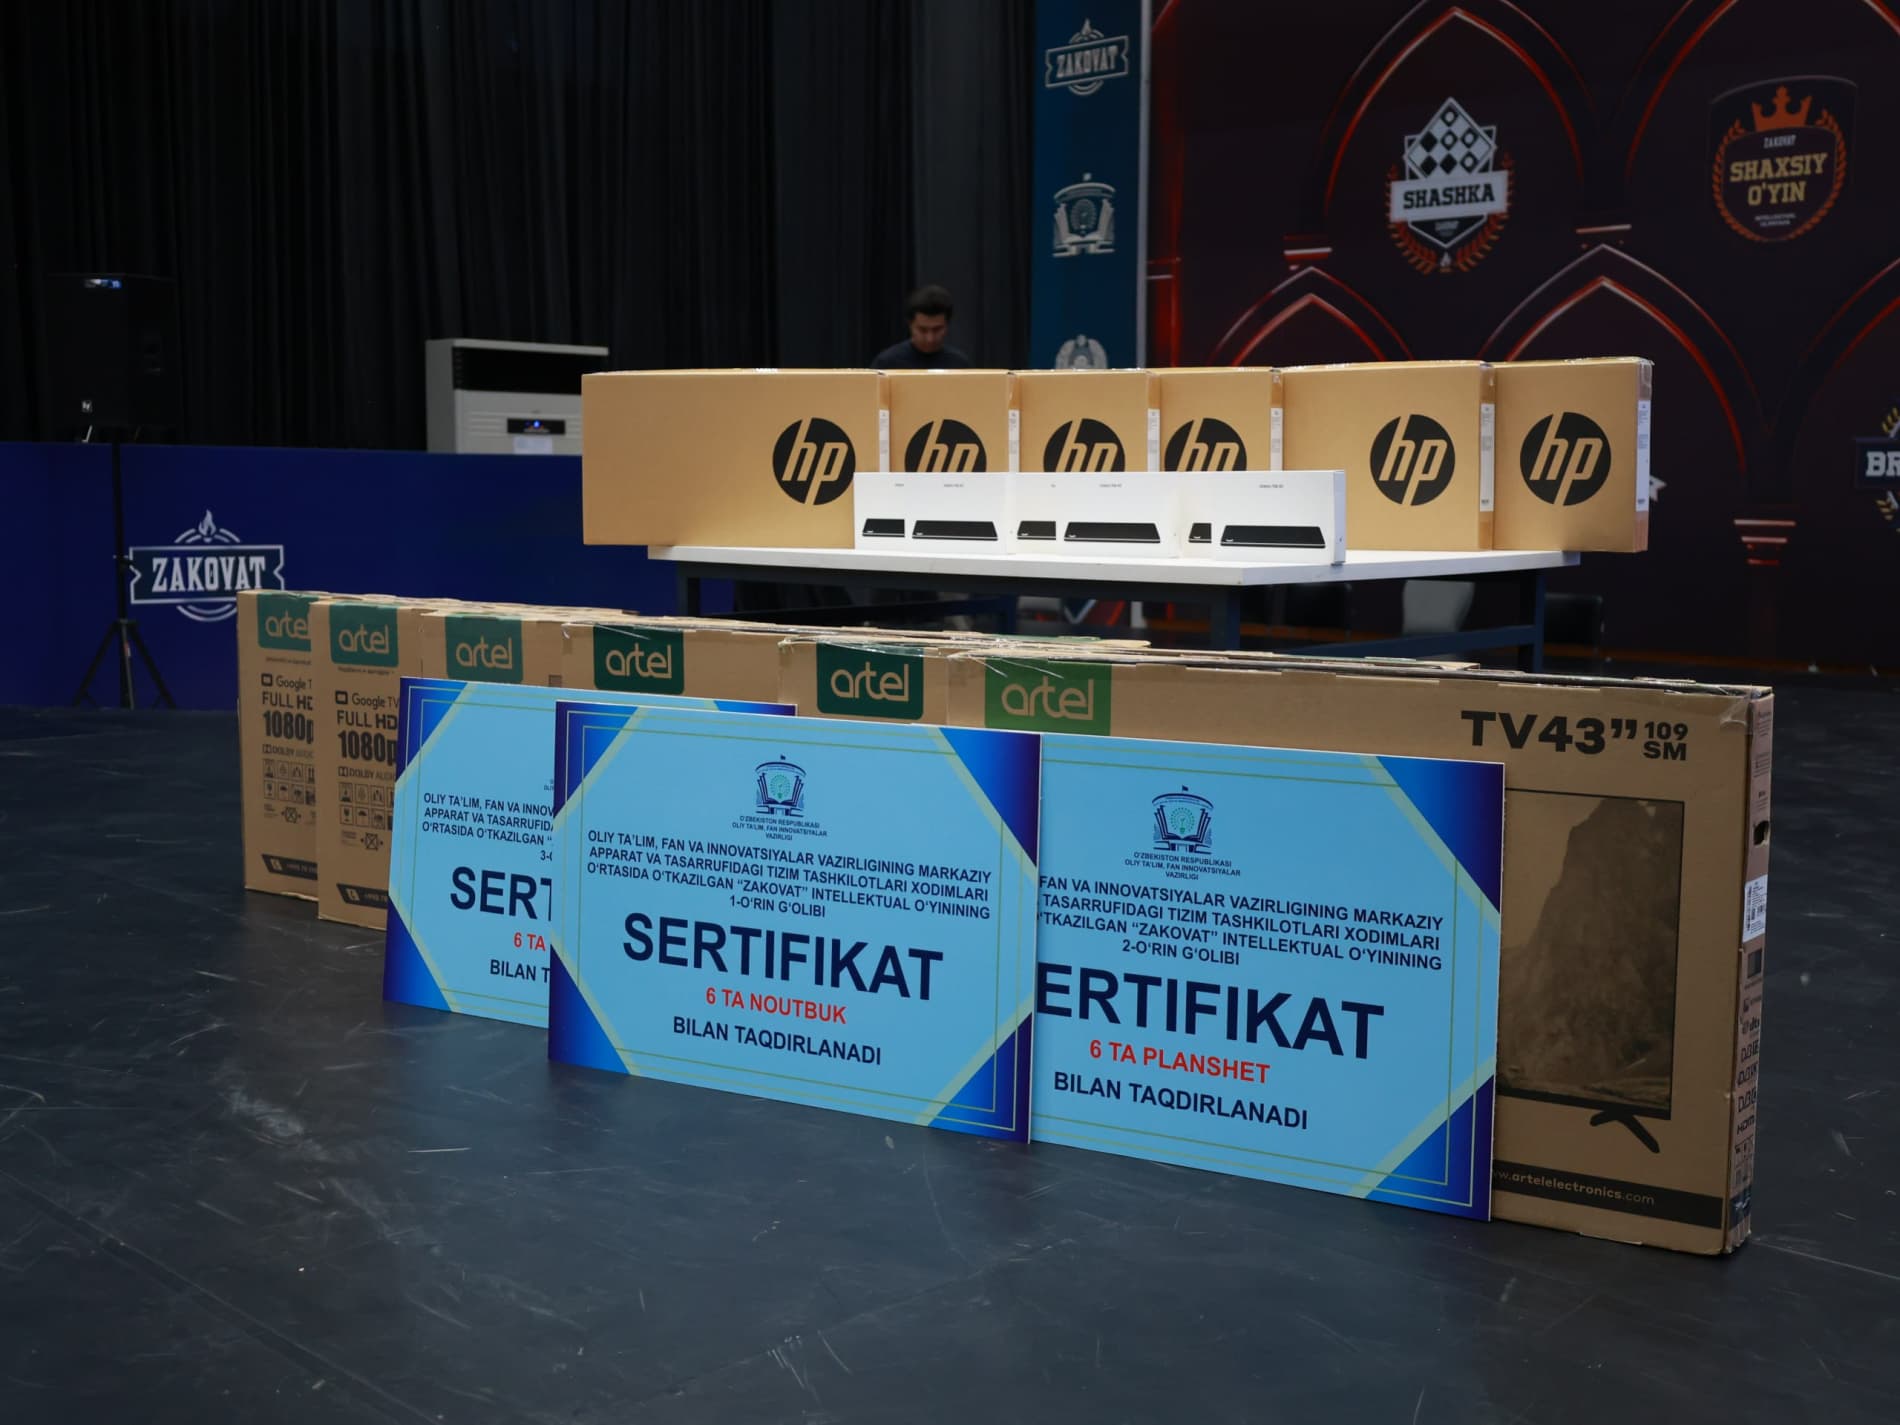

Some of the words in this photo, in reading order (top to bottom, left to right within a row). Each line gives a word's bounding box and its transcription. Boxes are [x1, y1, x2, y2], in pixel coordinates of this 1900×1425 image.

[1056, 45, 1118, 78] ZAKOVAT
[1729, 152, 1828, 182] SHAXSIY
[1403, 183, 1495, 210] SHASHKA
[1747, 181, 1807, 206] O'YIN
[781, 417, 849, 505] hp
[1378, 414, 1448, 506] hp
[1529, 412, 1603, 506] hp
[152, 556, 266, 592] ZAKOVAT
[338, 624, 390, 655] artel
[456, 636, 513, 670] artel
[606, 643, 672, 679] artel
[275, 675, 306, 692] Google
[830, 661, 910, 702] artel
[1001, 675, 1094, 721] artel
[262, 691, 294, 709] FULL
[352, 692, 385, 710] Google
[336, 710, 372, 728] FULL
[375, 713, 397, 730] HD
[1644, 721, 1688, 741] 109
[1643, 740, 1687, 761] SM
[423, 792, 446, 805] OLIY
[485, 799, 504, 811] FAN
[507, 802, 520, 813] VA
[424, 807, 469, 820] APPARAT
[471, 813, 485, 824] VA
[486, 814, 553, 832] TASARRUFID
[588, 830, 615, 844] OLIY
[661, 837, 685, 851] FAN
[688, 840, 704, 853] VA
[707, 842, 814, 866] INNOVATSIYALAR
[818, 854, 915, 876] VAZIRLIGINING
[918, 865, 992, 884] MARKAZIY
[1124, 859, 1140, 867] OLIY
[1166, 862, 1180, 871] FAN
[1181, 864, 1241, 877] INNOVATSIYALAR
[1180, 855, 1232, 868] RESPUBLIKASI
[589, 847, 642, 863] APPARAT
[646, 852, 661, 865] VA
[665, 854, 763, 877] TASARRUFIDAGI
[767, 865, 800, 881] TIZIM
[803, 869, 907, 892] TASHKILOTLARI
[911, 881, 988, 902] XODIMLARI
[1165, 871, 1199, 880] VAZIRLIGI
[811, 887, 910, 910] INTELLEKTUAL
[1039, 876, 1067, 890] FAN
[1072, 879, 1090, 894] VA
[1094, 880, 1225, 907] INNOVATSIYALAR
[1229, 895, 1348, 921] VAZIRLIGINING
[1354, 908, 1443, 931] MARKAZIY
[1037, 912, 1127, 934] ‘TKAZILGAN
[1223, 932, 1344, 959] INTELLEKTUAL
[1043, 894, 1163, 919] TASARRUFIDAGI
[1168, 907, 1207, 924] TIZIM
[1212, 913, 1340, 939] TASHKILOTLARI
[1345, 926, 1440, 950] XODIMLARI
[513, 932, 523, 949] 6
[527, 933, 546, 952] TA
[623, 912, 944, 1001] SERTIFIKAT
[490, 959, 537, 982] BILAN
[706, 987, 716, 1005] 6
[722, 989, 745, 1010] TA
[750, 991, 847, 1025] NOUTBUK
[1036, 961, 1385, 1060] ERTIFIKAT
[673, 1016, 729, 1041] BILAN
[734, 1025, 881, 1066] TAQDIRLANADI
[1089, 1039, 1102, 1058] 6
[1109, 1041, 1136, 1064] TA
[1143, 1046, 1271, 1084] PLANSHET
[1054, 1071, 1121, 1100] BILAN
[1129, 1082, 1308, 1130] TAQDIRLANADI
